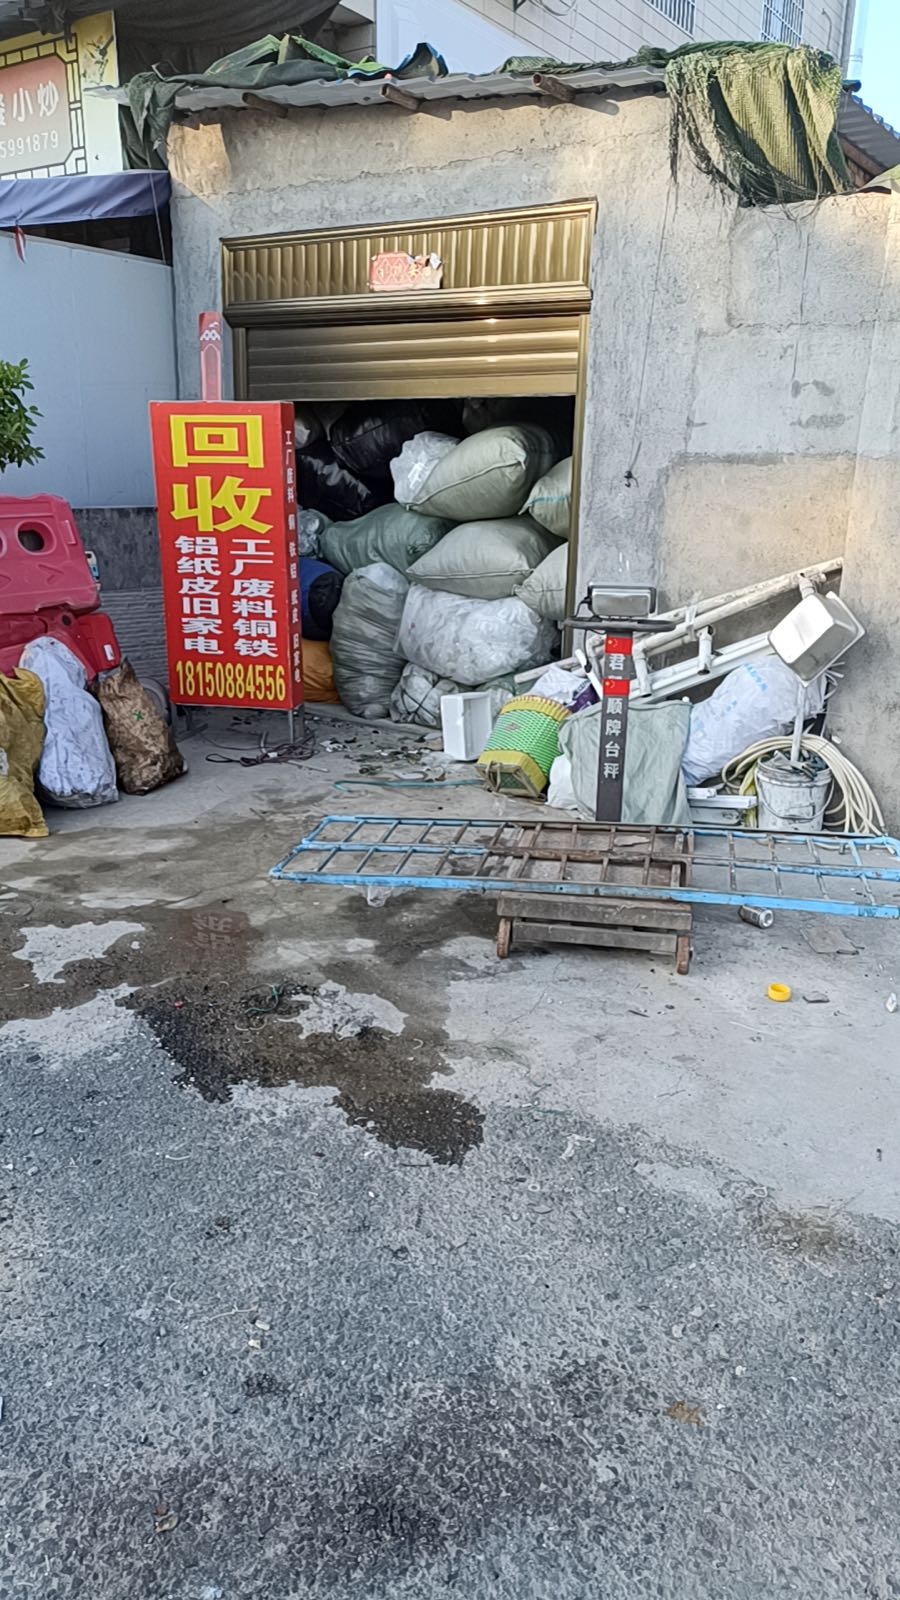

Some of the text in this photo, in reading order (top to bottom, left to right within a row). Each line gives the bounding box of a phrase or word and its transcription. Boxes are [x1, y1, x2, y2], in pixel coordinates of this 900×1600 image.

[0, 80, 59, 126] 小炒
[0, 130, 58, 158] 5991879
[170, 415, 274, 534] 回收
[174, 535, 224, 655] 铝纸皮旧家电
[229, 539, 279, 658] 工厂废料铜铁
[176, 660, 286, 701] 18150884556
[603, 653, 626, 779] 君顺牌台秤
